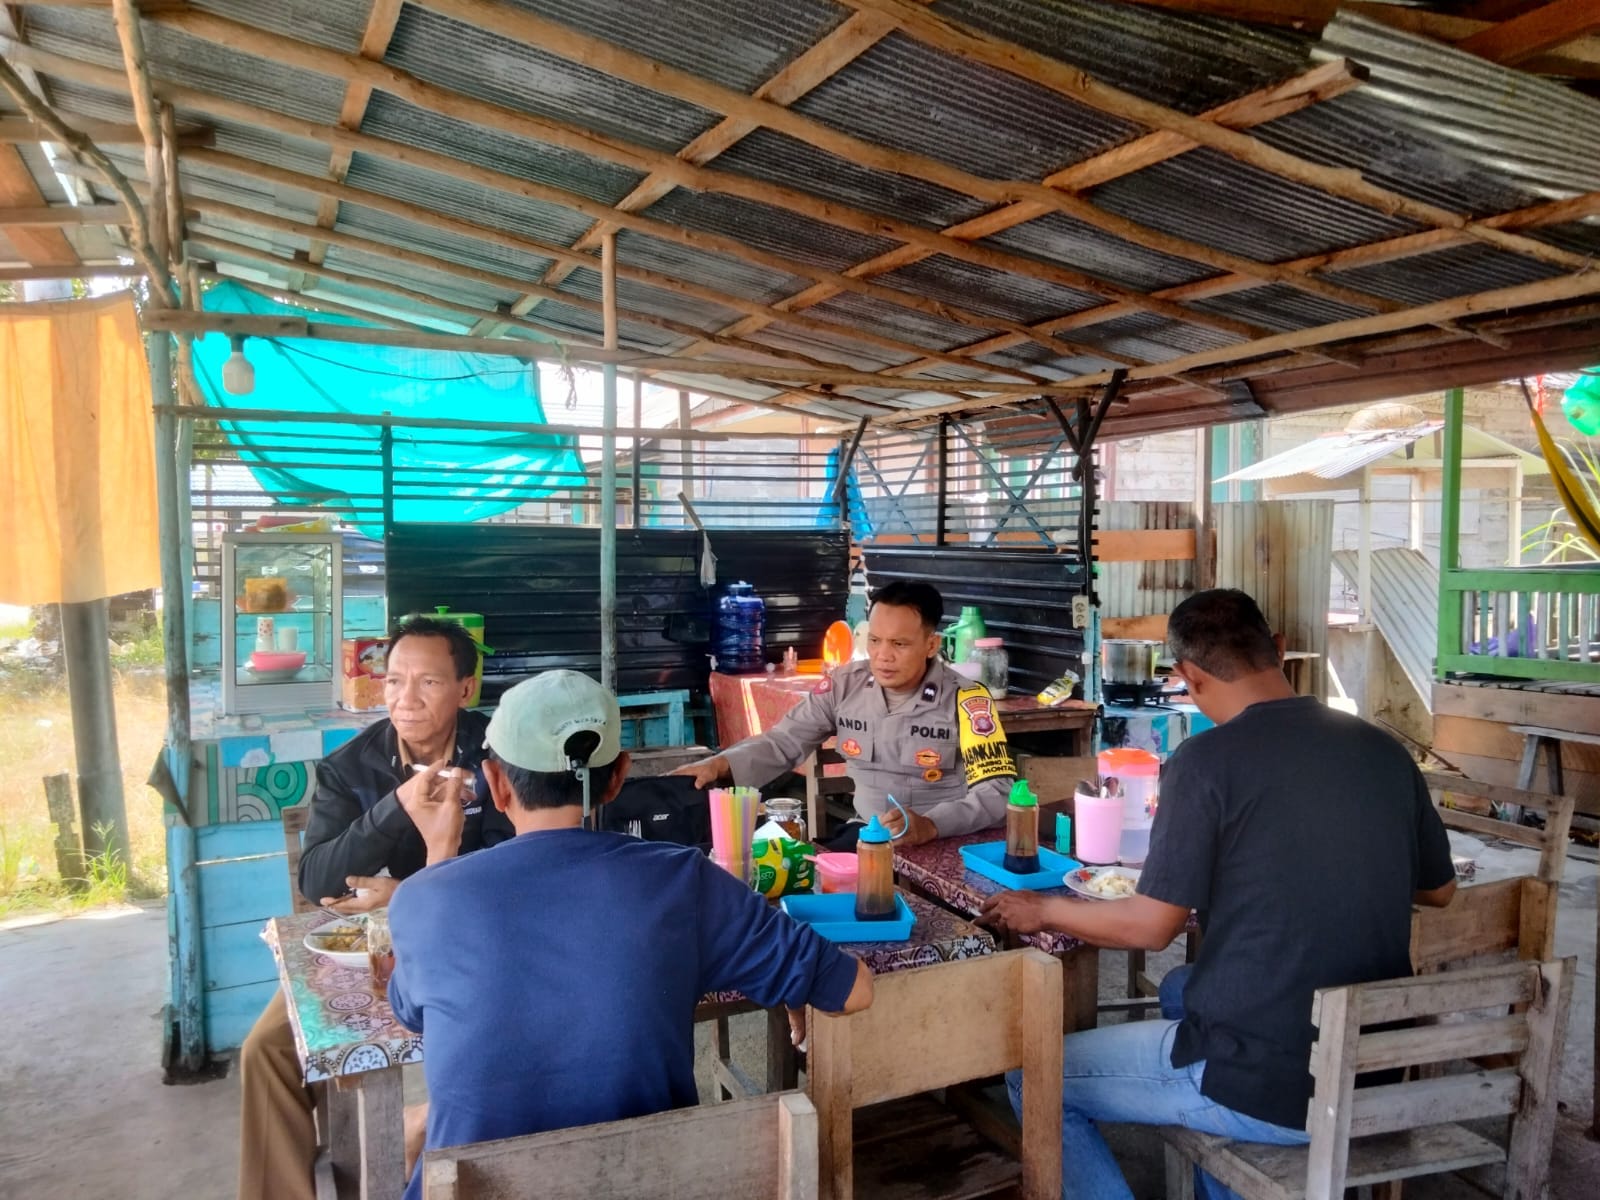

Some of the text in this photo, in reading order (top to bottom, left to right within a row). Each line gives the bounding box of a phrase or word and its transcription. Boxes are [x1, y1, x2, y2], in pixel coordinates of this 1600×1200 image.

[838, 717, 867, 732] ANDI
[910, 725, 951, 740] POLRI
[652, 813, 671, 822] acer
